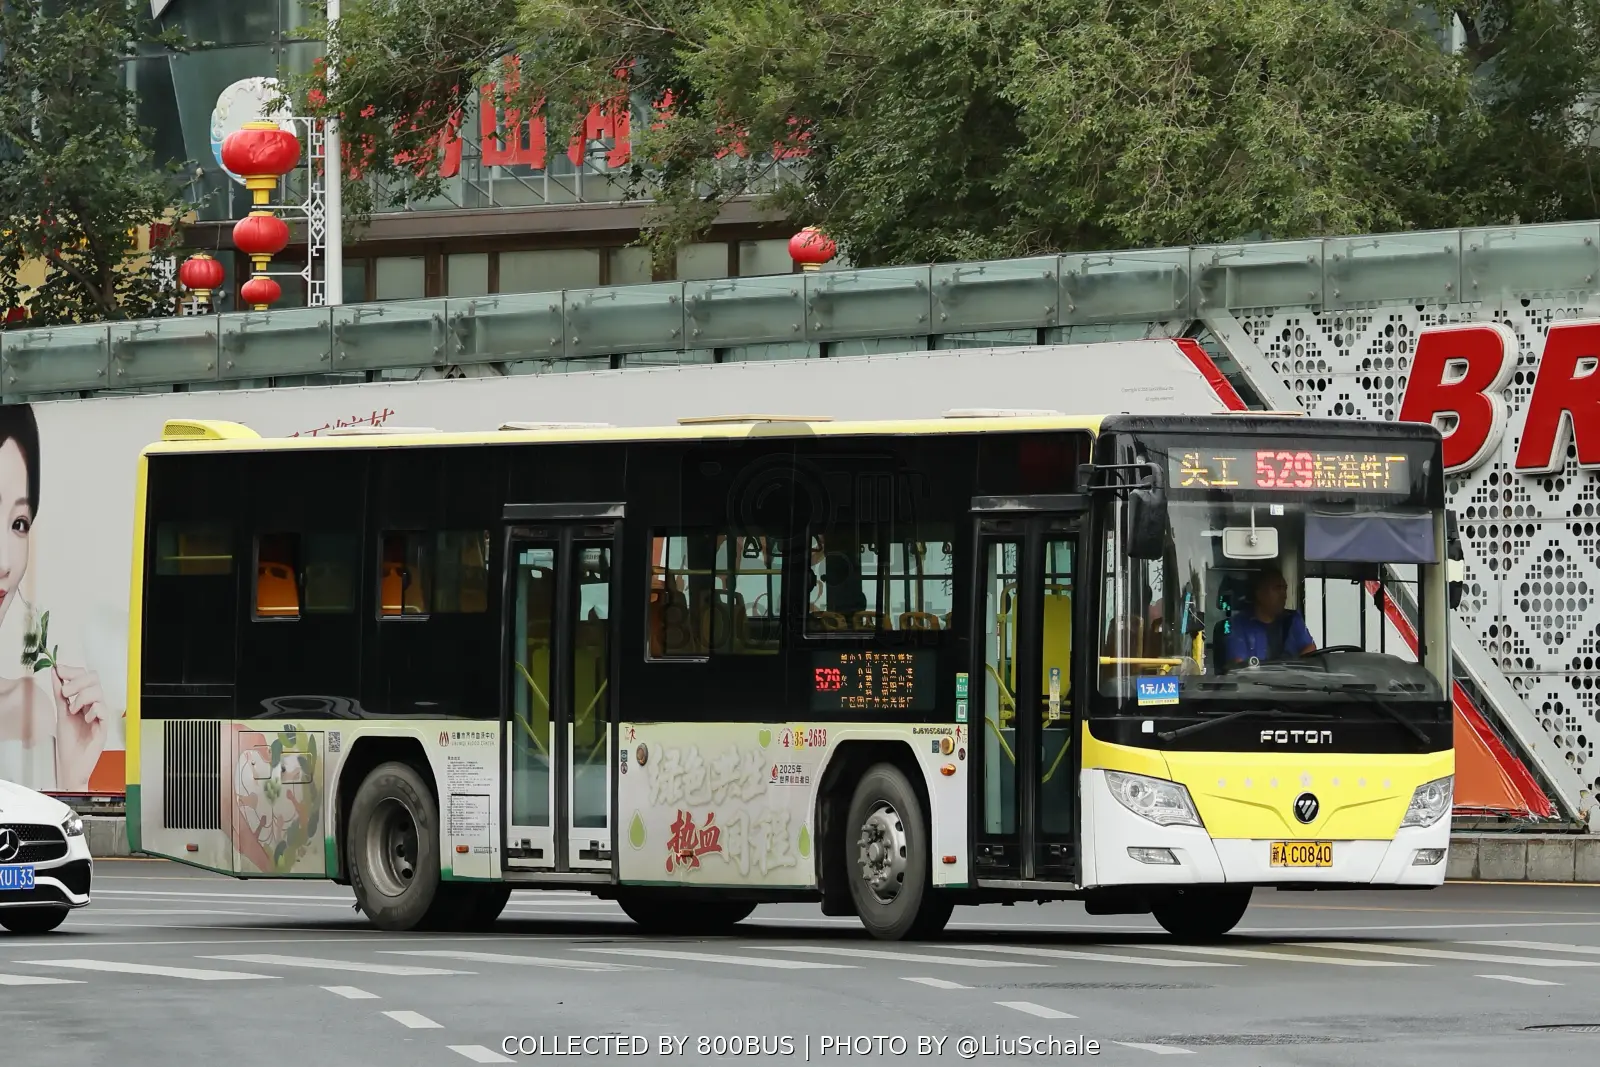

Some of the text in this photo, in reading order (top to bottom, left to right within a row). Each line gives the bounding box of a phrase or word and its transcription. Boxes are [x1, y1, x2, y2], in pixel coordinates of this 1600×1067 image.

[1180, 451, 1406, 488] 头工 529 标准件厂
[815, 668, 841, 690] 529
[1140, 682, 1177, 695] 1元/人次
[1260, 730, 1333, 744] FOTON
[779, 764, 802, 775] 2025年
